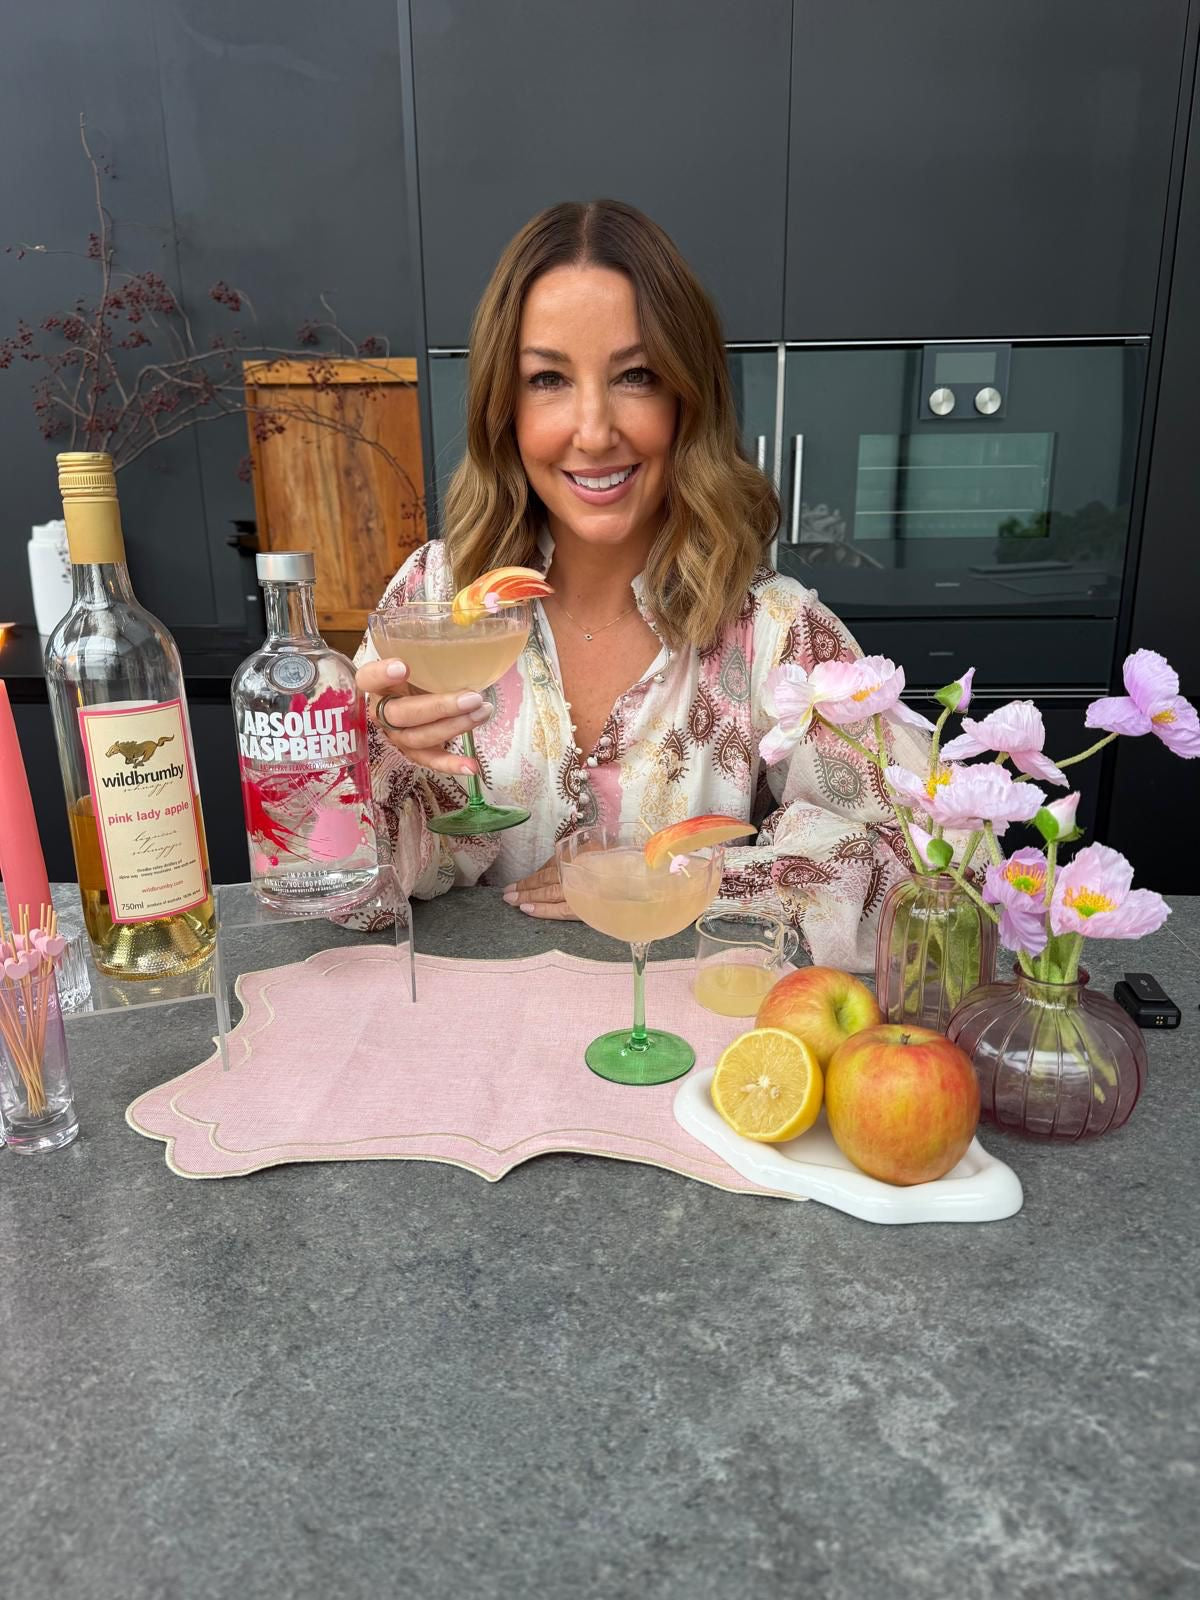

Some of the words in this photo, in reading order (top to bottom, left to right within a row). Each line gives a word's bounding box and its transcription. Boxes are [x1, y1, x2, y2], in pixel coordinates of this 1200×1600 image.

[244, 706, 345, 737] ABSOLUT
[239, 729, 357, 761] RASPBERRI
[102, 763, 184, 788] wildbrumby
[108, 813, 133, 826] pink
[136, 809, 161, 821] lady
[164, 801, 189, 816] apple
[142, 880, 184, 893] wildbrumby.com
[286, 870, 328, 879] IMPORTED
[121, 901, 144, 911] 750ml
